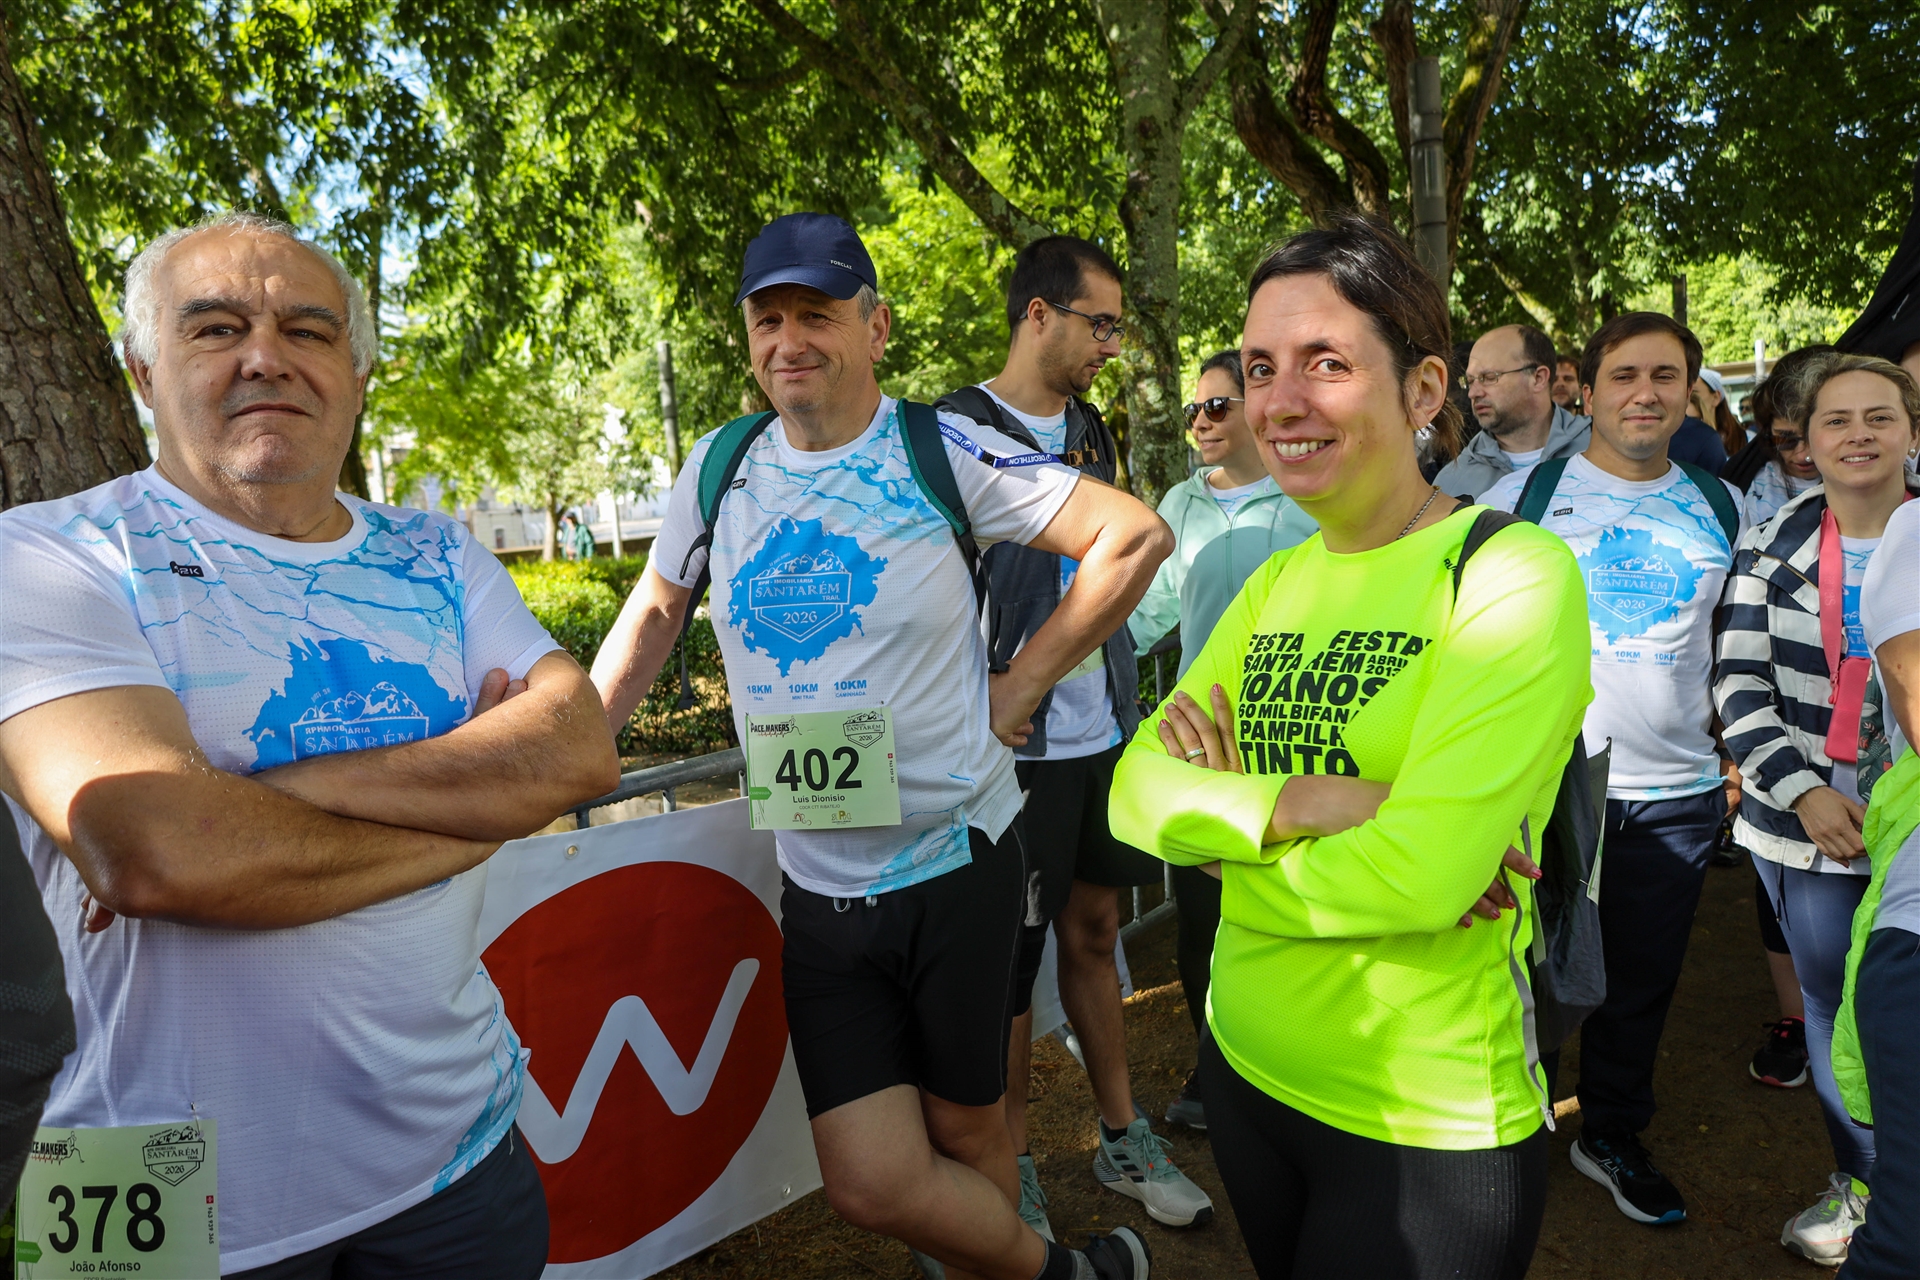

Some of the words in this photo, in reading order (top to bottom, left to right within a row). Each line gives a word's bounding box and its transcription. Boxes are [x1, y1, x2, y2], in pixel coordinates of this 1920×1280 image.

[830, 260, 852, 270] FORCLAZ
[1008, 454, 1046, 464] DECATHLON
[755, 581, 840, 597] SANTARÉM
[1596, 578, 1668, 590] SANTARÉM
[1616, 598, 1646, 609] 2026
[782, 611, 818, 624] 2026
[1249, 633, 1304, 653] FESTA
[747, 685, 772, 694] 18KM
[788, 683, 818, 693] 10KM
[834, 680, 867, 690] 10KM
[1239, 703, 1256, 718] 60
[1258, 704, 1288, 719] MIL
[765, 724, 790, 732] MAKERS
[1239, 742, 1360, 777] TINTO
[775, 746, 862, 791] 402
[40, 1142, 68, 1156] MAKERS
[148, 1147, 198, 1159] SANTARÉM
[165, 1165, 185, 1174] 2026
[48, 1182, 165, 1253] 378
[70, 1260, 96, 1272] João
[99, 1260, 141, 1272] Afonso
